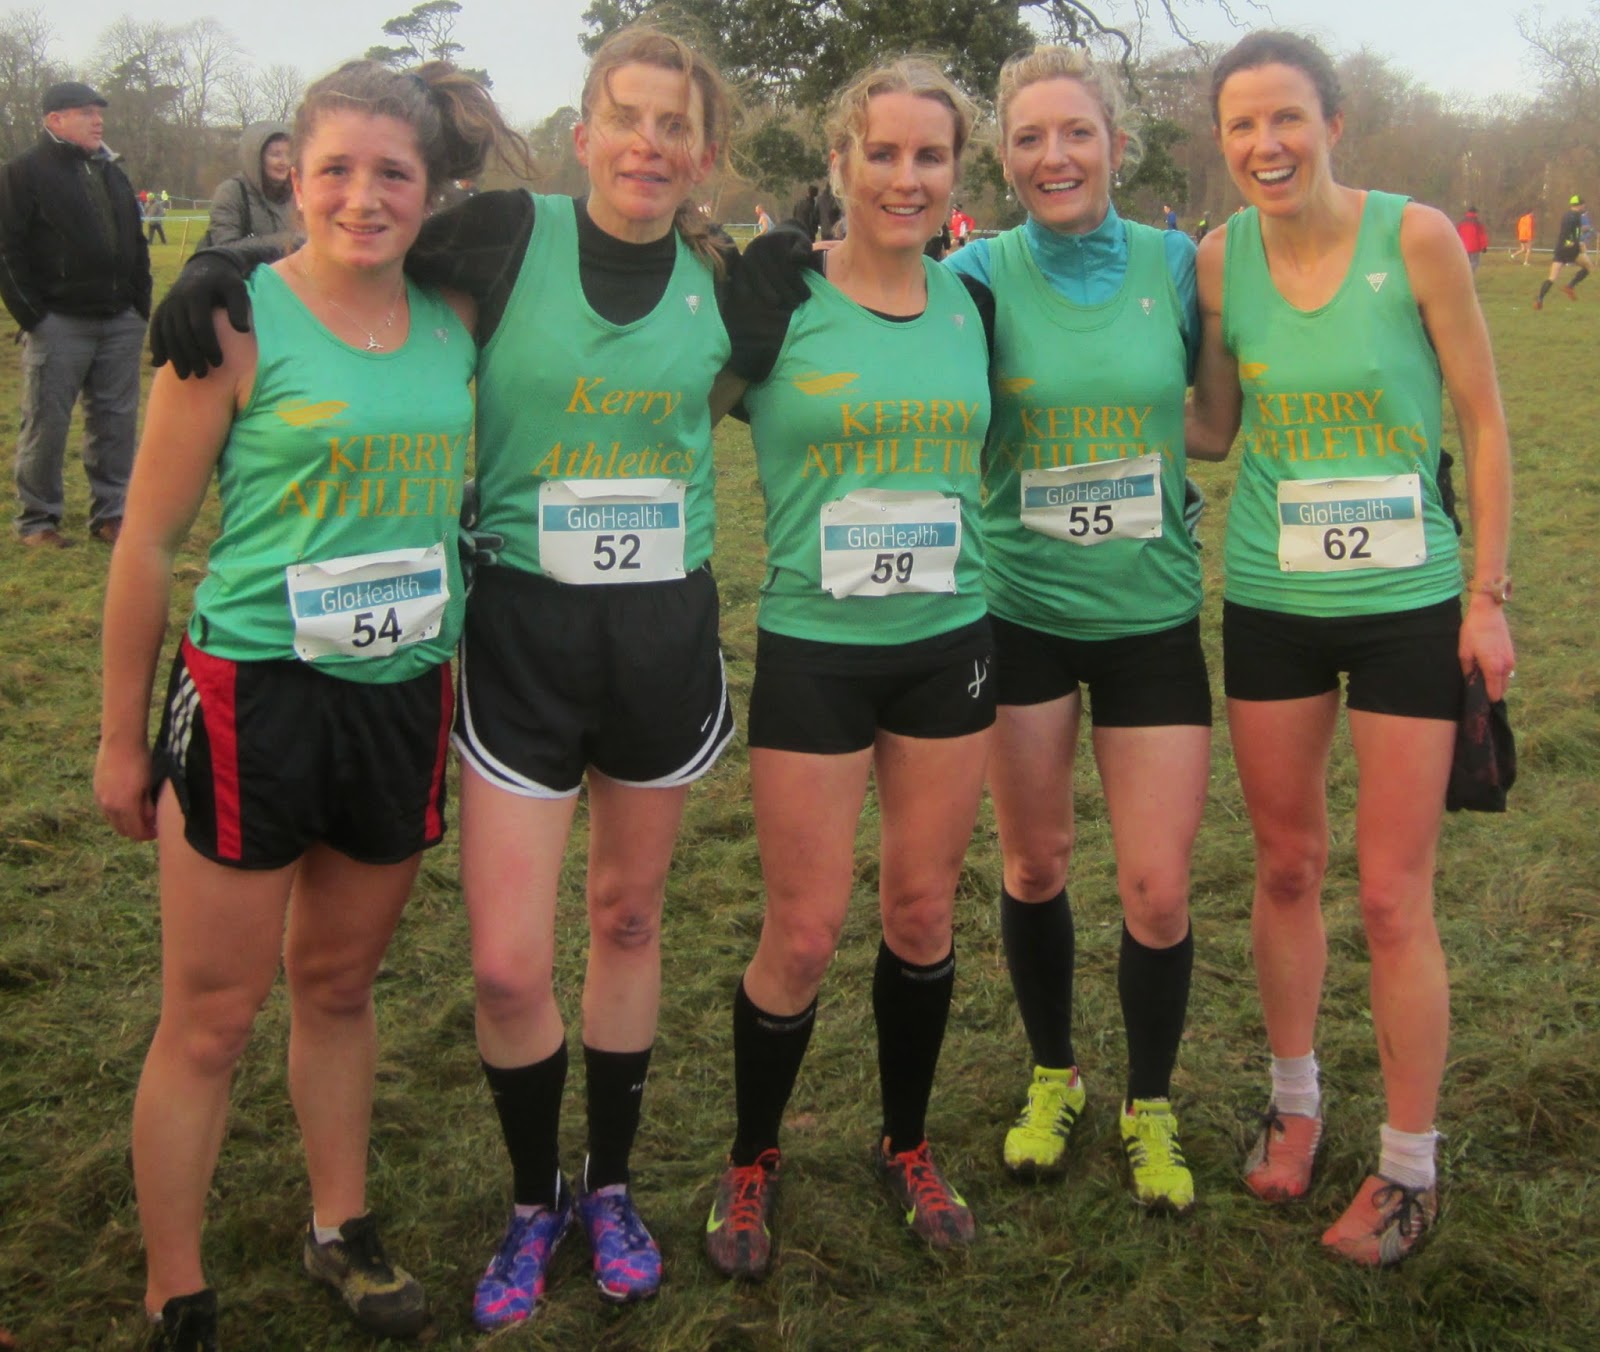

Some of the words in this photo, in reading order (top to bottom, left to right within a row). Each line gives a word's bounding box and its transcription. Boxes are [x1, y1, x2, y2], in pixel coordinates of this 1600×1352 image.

[564, 376, 683, 424] Kerry
[1256, 389, 1383, 425] KERRY
[840, 399, 980, 437] KERRY
[1021, 406, 1152, 439] KERRY
[328, 432, 463, 475] KERRY
[532, 440, 696, 479] Athletics
[1046, 479, 1134, 506] GloHealth
[566, 507, 664, 529] GloHealth
[1068, 504, 1114, 537] 55
[1299, 500, 1392, 525] GloHealth
[593, 533, 642, 571] 52
[847, 525, 940, 549] GloHealth
[1322, 526, 1372, 561] 62
[870, 551, 914, 585] 59
[320, 576, 421, 614] GloHealth
[351, 606, 403, 649] 54
